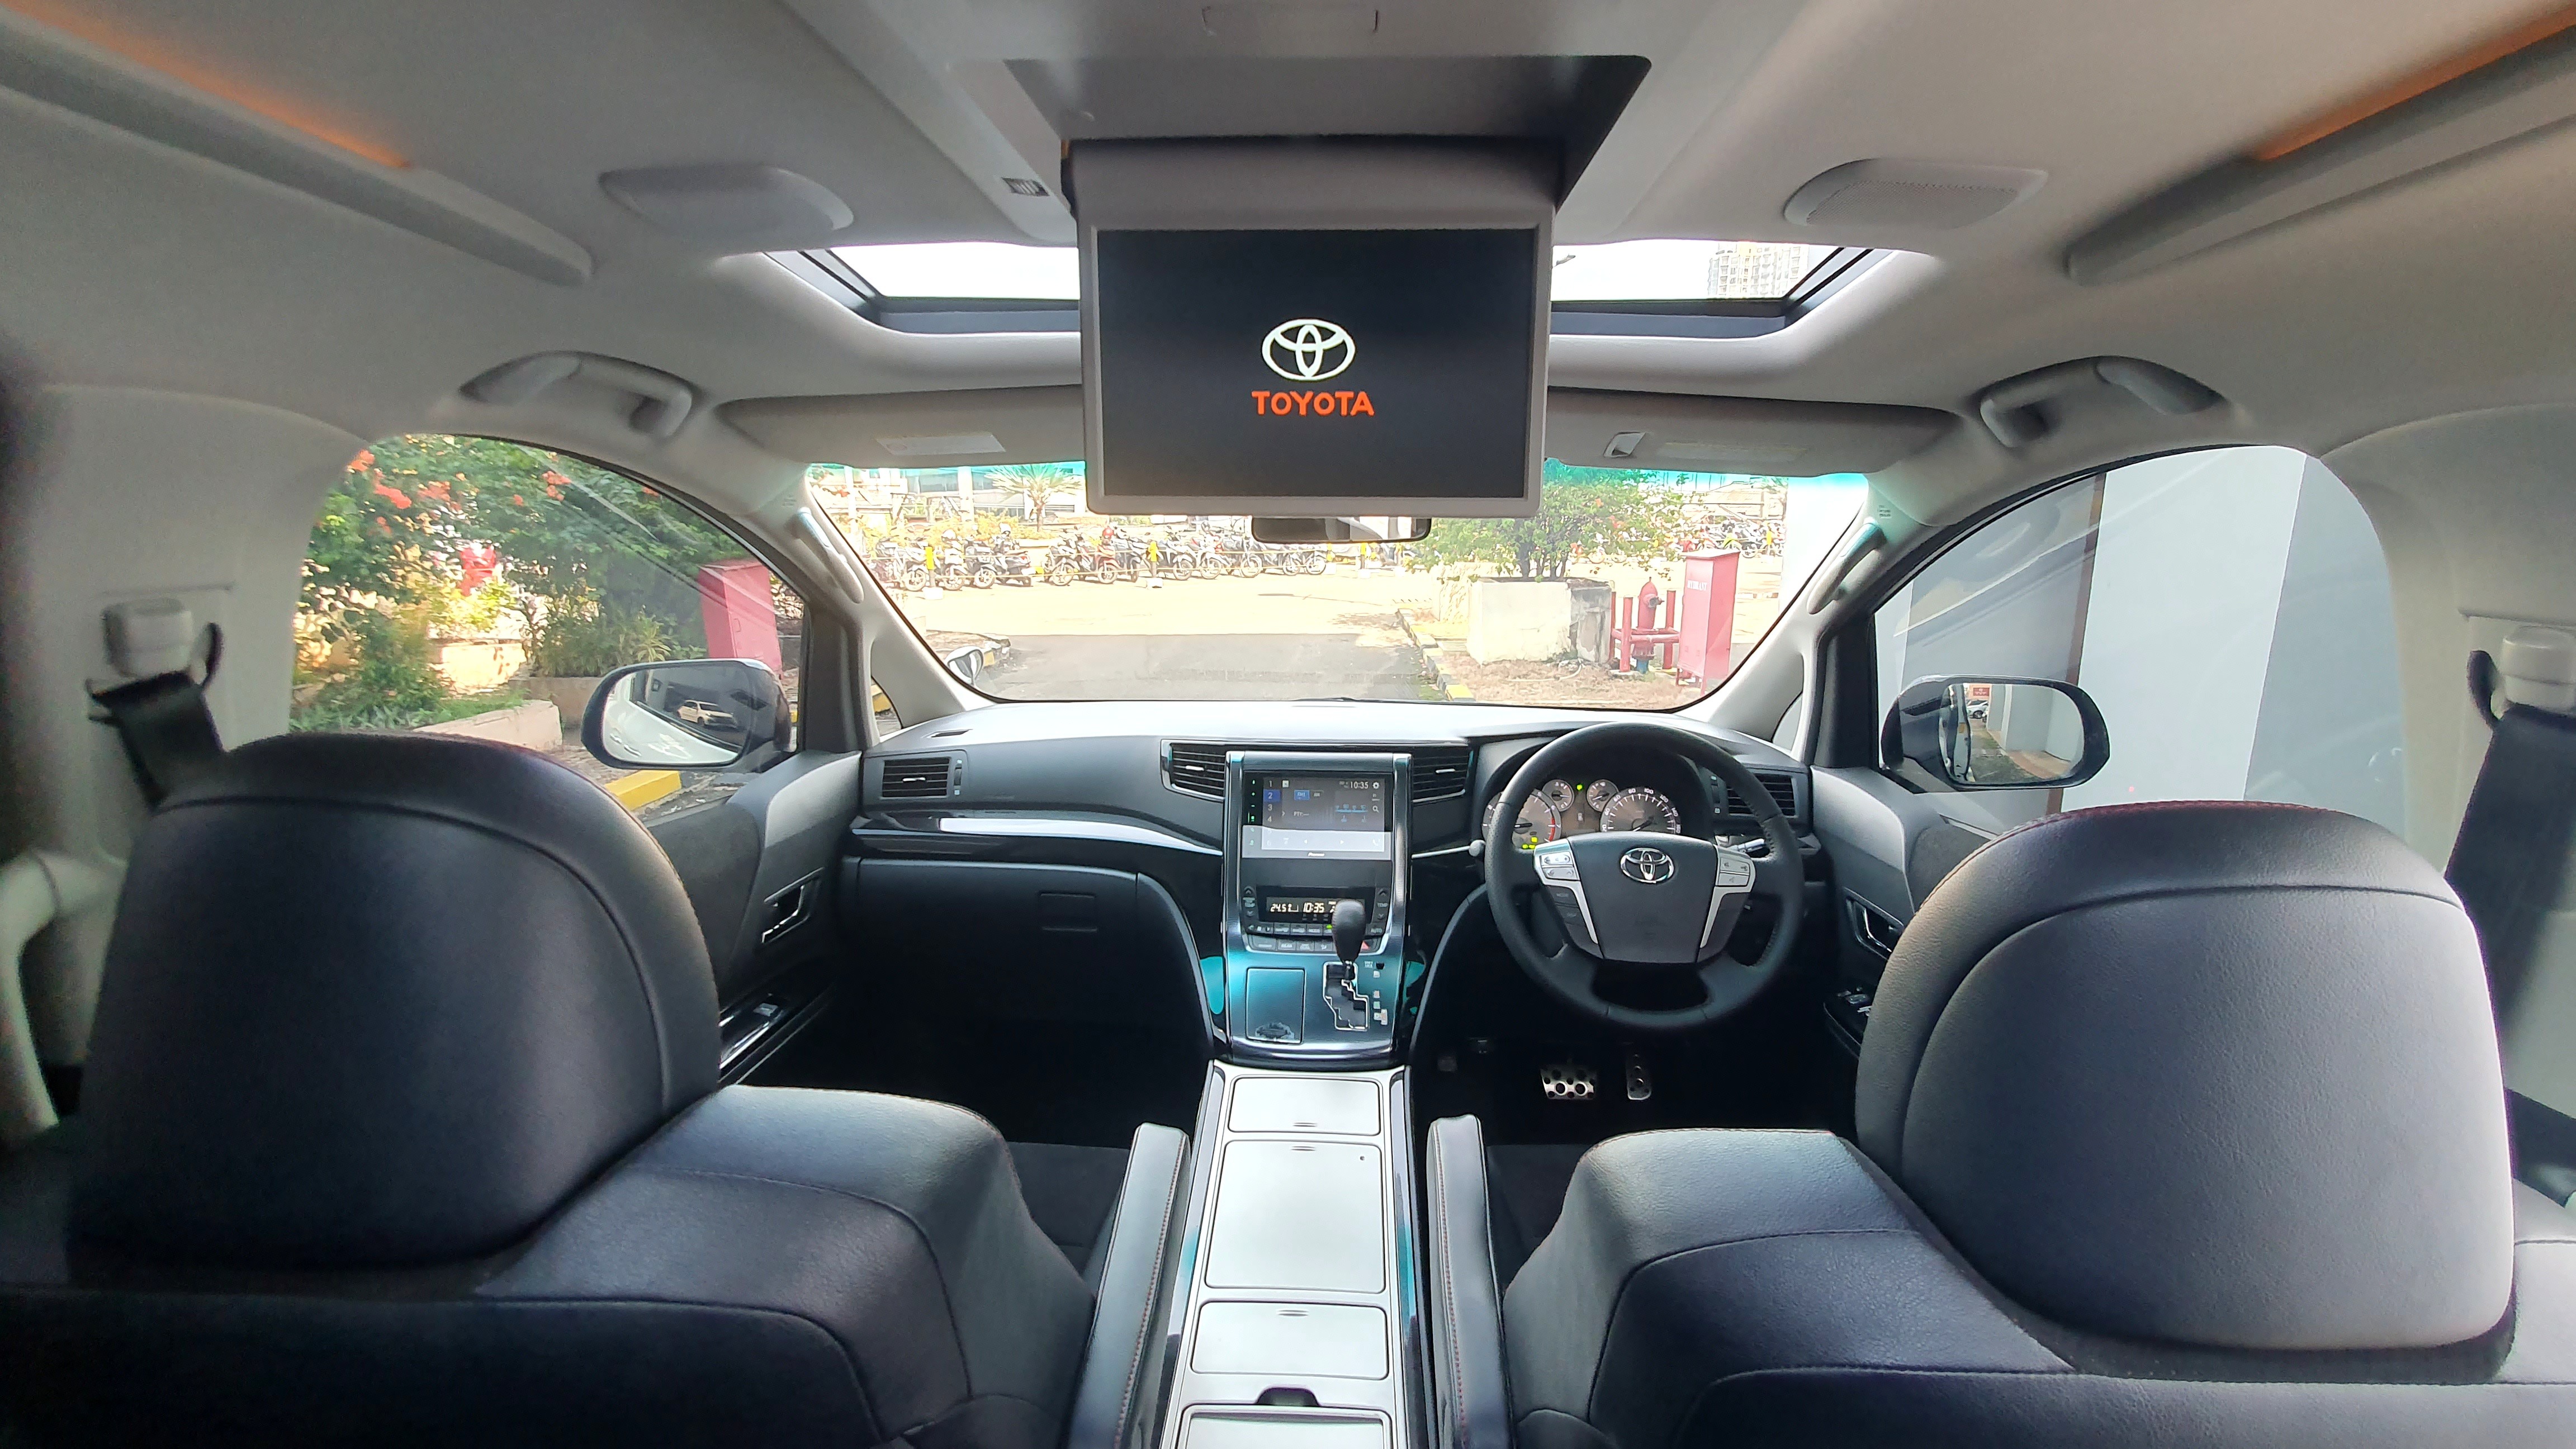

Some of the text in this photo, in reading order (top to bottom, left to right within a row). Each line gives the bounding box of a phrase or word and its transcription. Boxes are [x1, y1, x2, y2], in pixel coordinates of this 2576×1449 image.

[1251, 391, 1375, 416] TOYOTA
[1349, 781, 1368, 789] 10:35
[1660, 794, 1669, 803] 120
[1270, 903, 1287, 912] 24.5
[1303, 902, 1324, 913] 10:35
